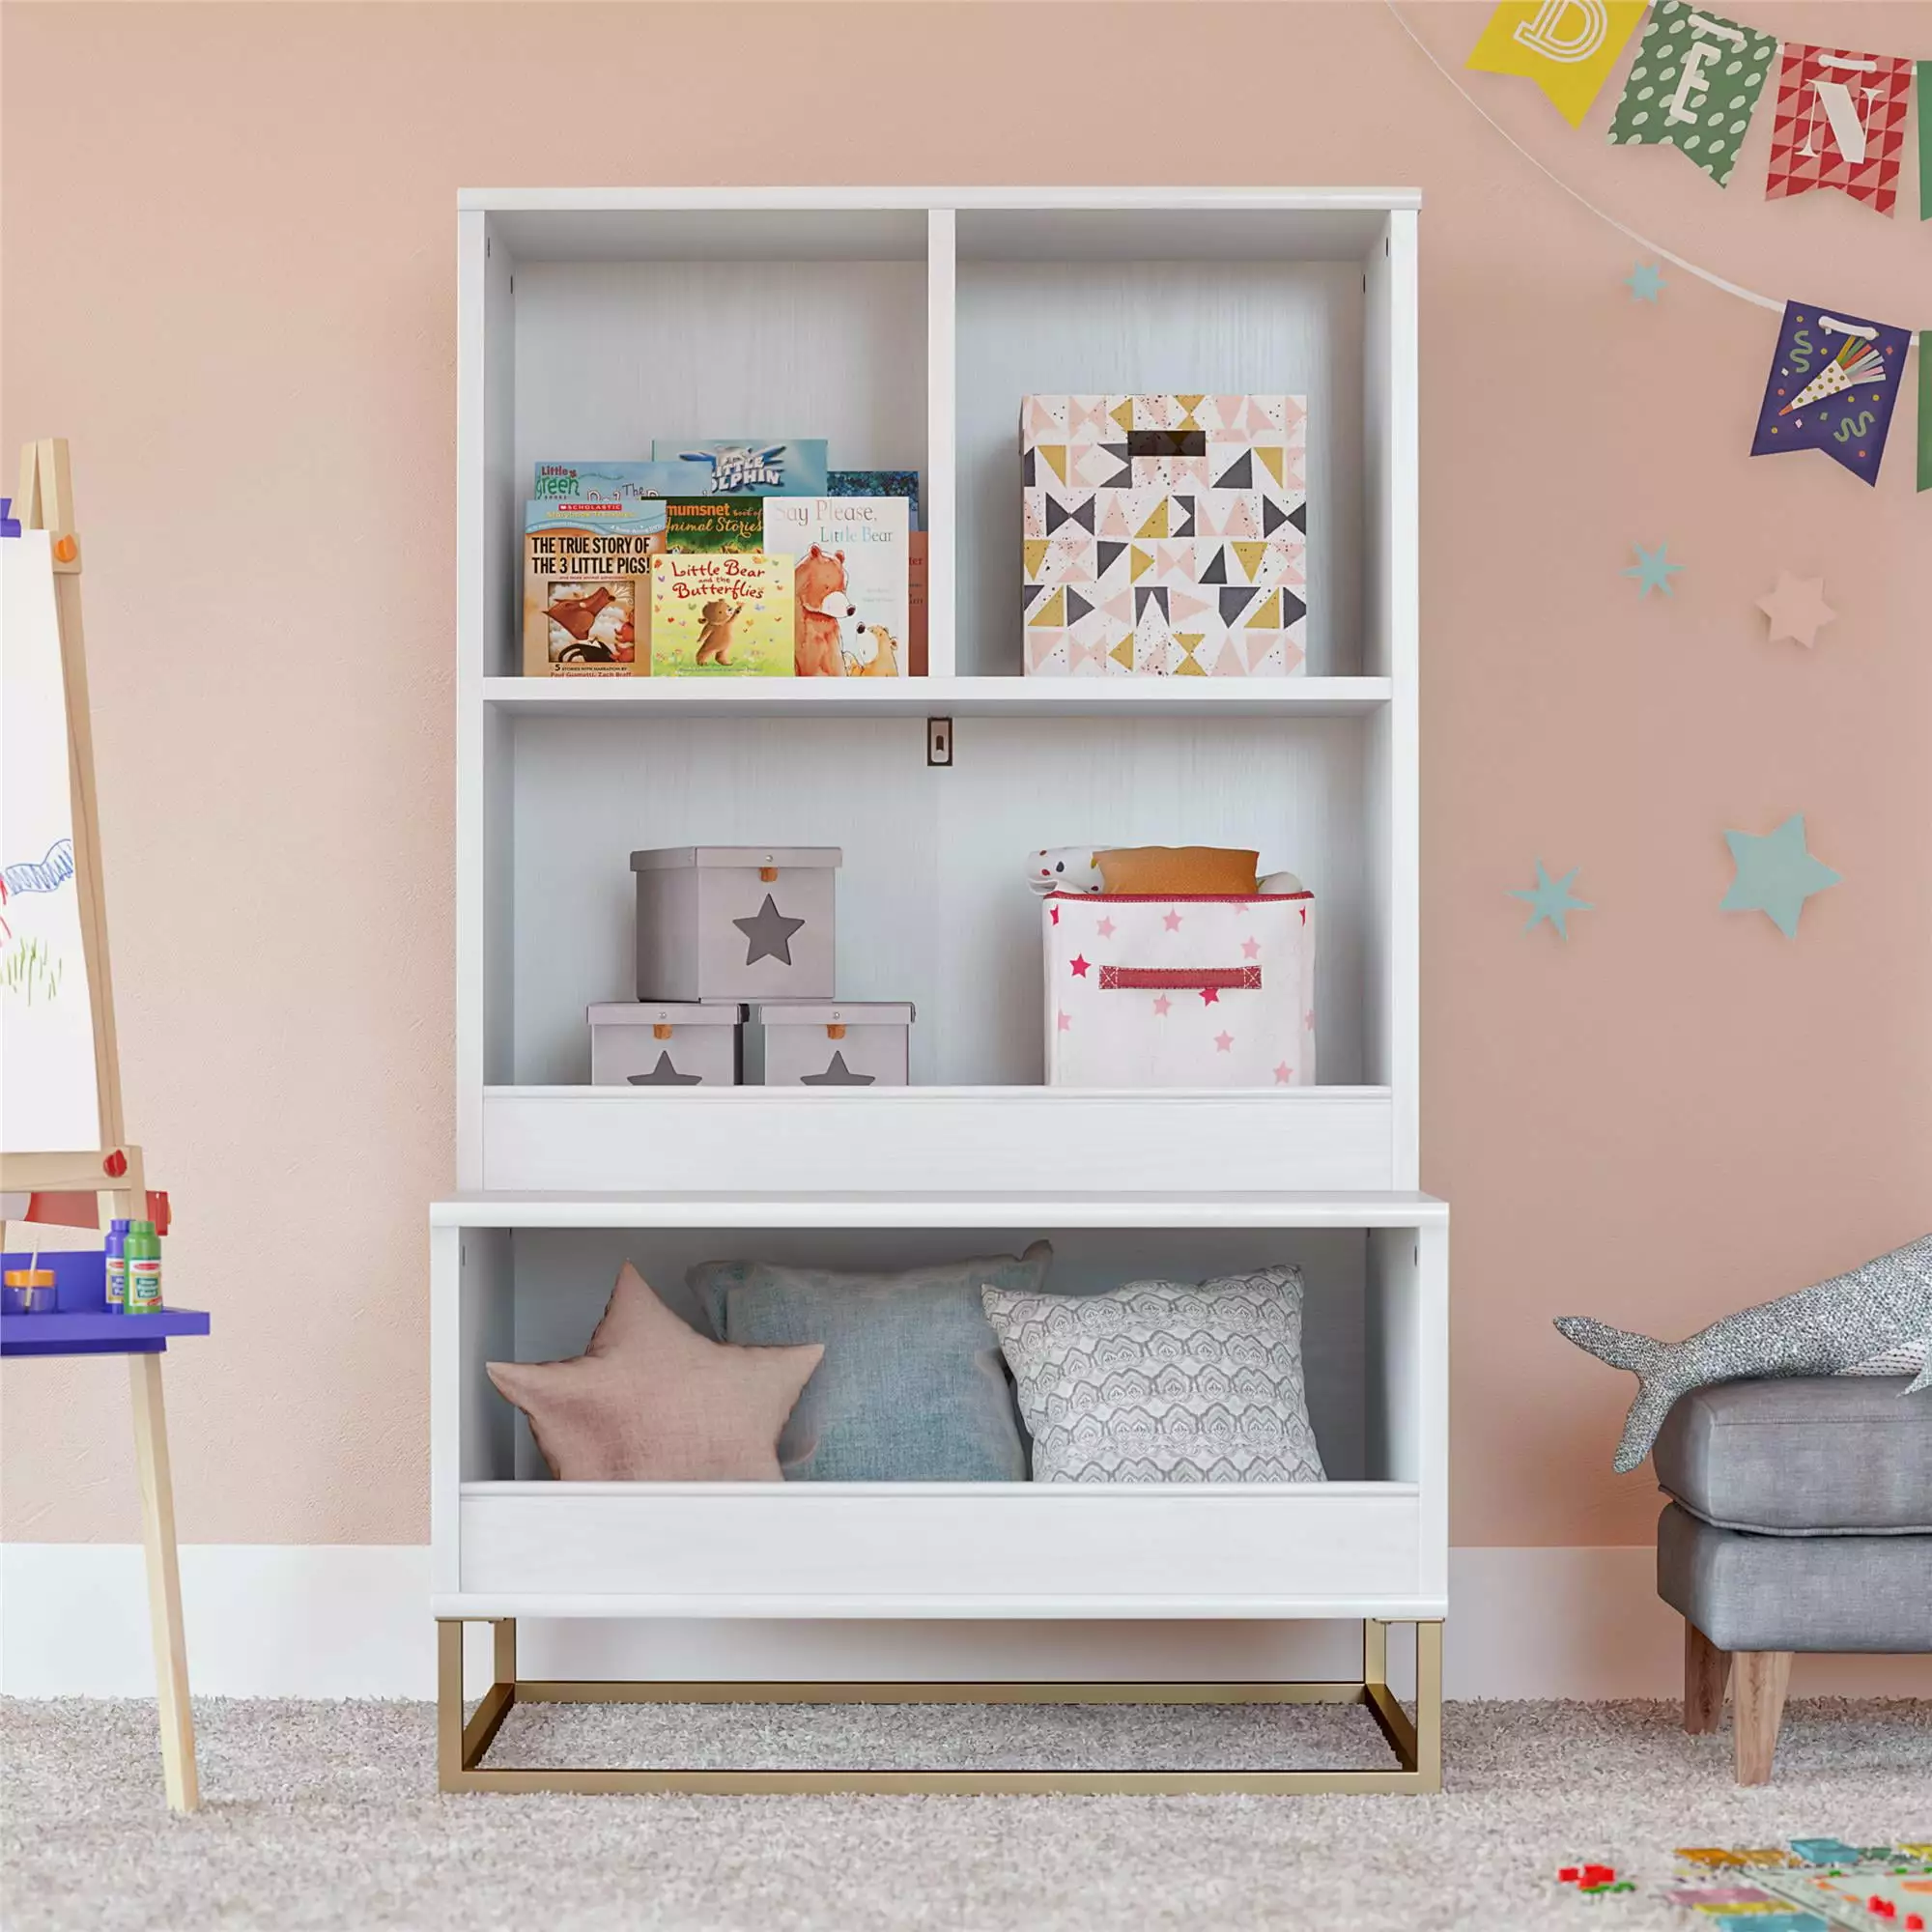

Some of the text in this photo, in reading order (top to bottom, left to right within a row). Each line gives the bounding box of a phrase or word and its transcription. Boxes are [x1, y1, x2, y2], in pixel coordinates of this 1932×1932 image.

[541, 465, 569, 476] Little
[711, 455, 765, 477] ITTLE
[536, 476, 581, 499] green
[621, 483, 645, 497] The
[711, 469, 781, 493] OLPHIN
[667, 503, 730, 516] mumsnet
[775, 499, 878, 526] Say Please,
[716, 516, 764, 538] Stories
[820, 526, 894, 542] Little Bear
[531, 537, 650, 554] THE TRUE STORY OF
[531, 556, 650, 574] THE 3 LITTLE PIGS!
[670, 558, 766, 578] Little Bear
[671, 580, 765, 600] Butterflies
